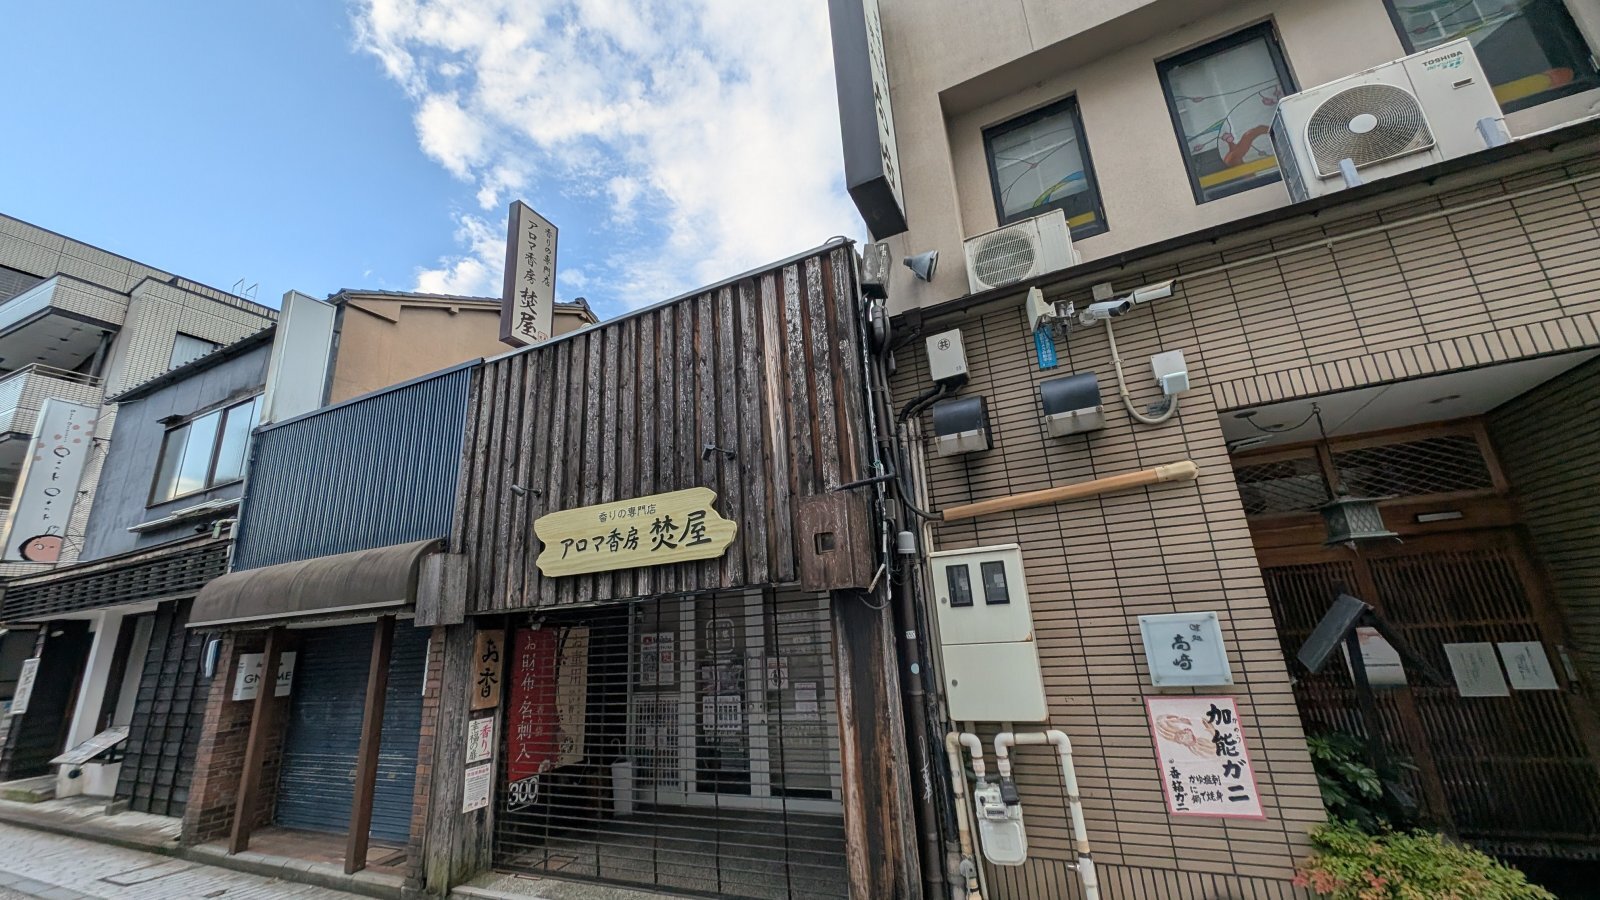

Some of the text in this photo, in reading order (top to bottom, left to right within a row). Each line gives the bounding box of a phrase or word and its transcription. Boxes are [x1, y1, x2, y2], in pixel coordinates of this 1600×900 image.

[1422, 50, 1463, 67] TOSHIBA
[516, 220, 539, 340] アロマ香房 焚屋
[542, 228, 552, 287] 香りの専門店
[560, 509, 712, 560] アロマ香房 焚屋
[598, 504, 657, 523] 香りの専門店
[244, 672, 292, 683] GNME
[477, 639, 499, 698] お香
[1206, 703, 1250, 802] 加能ガニ
[509, 777, 538, 805] 300
